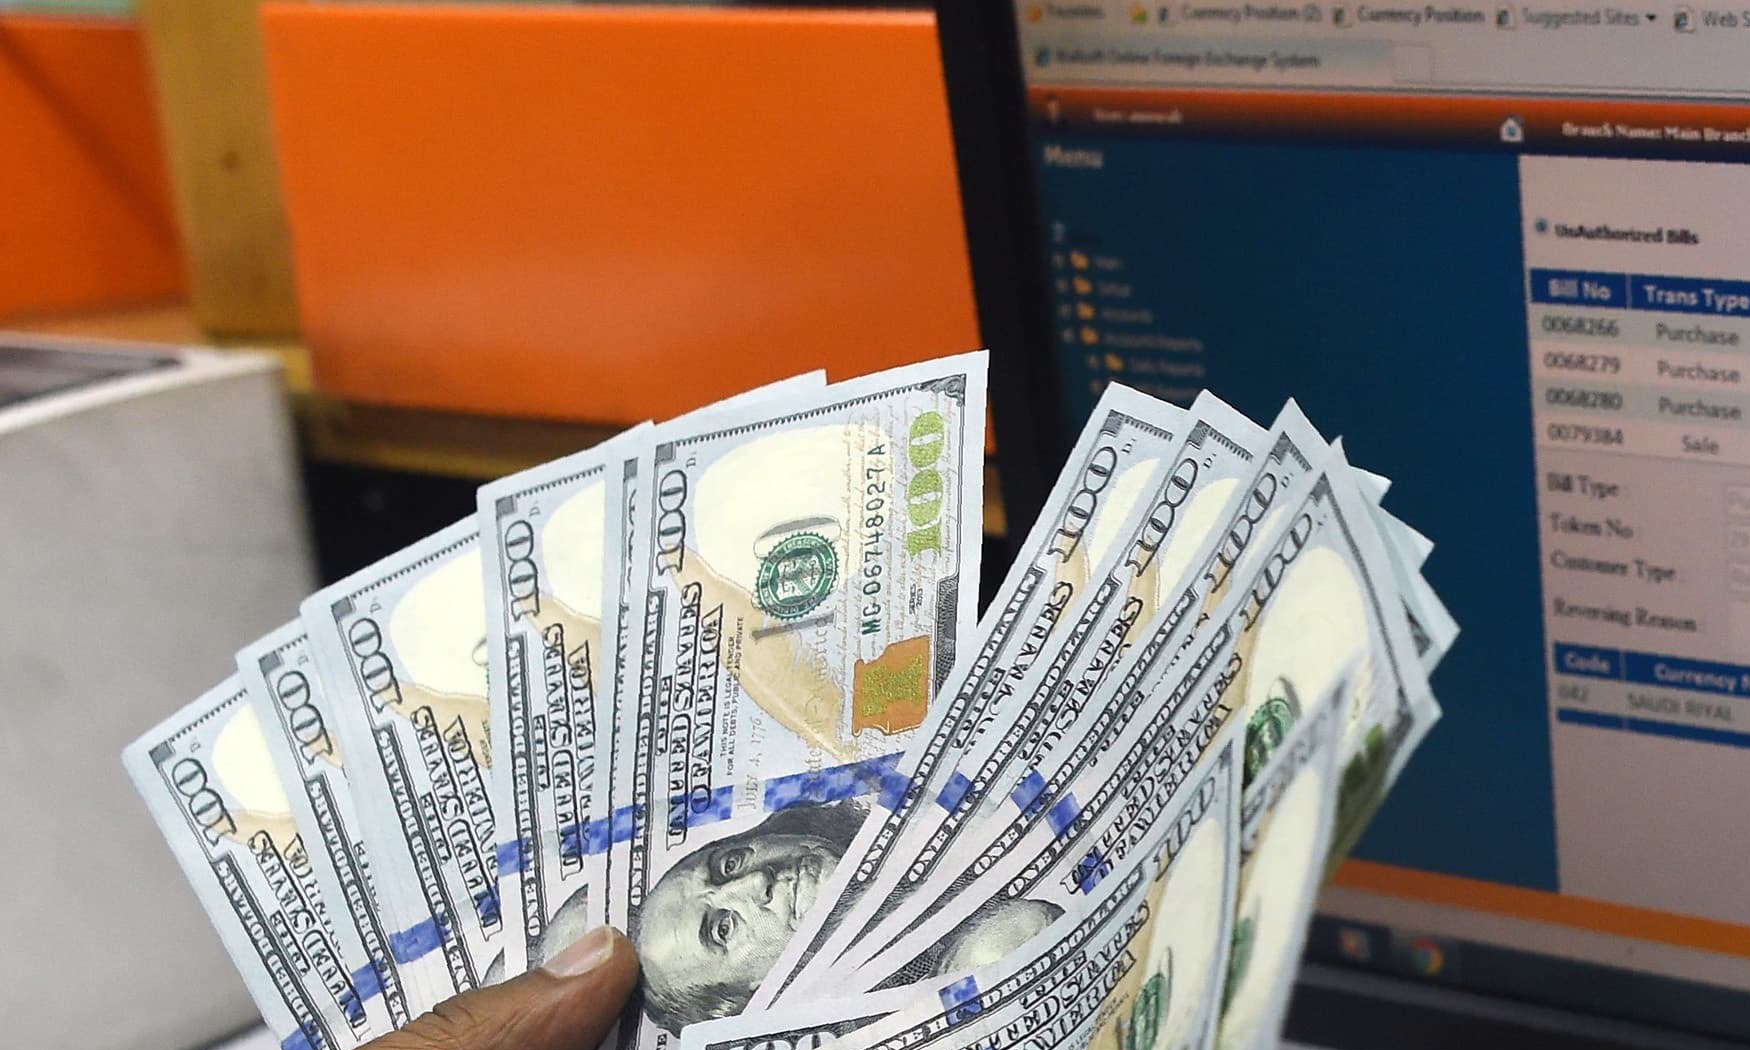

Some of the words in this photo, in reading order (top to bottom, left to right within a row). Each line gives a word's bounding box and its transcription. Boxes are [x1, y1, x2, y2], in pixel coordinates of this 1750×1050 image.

[1522, 9, 1600, 29] Suggested
[1704, 11, 1739, 27] Web
[1664, 125, 1701, 141] Main
[1554, 223, 1663, 245] UnAuthorized
[1666, 230, 1699, 247] Bills
[1548, 279, 1578, 298] Bill
[1582, 282, 1612, 301] No
[1644, 285, 1698, 306] Trans
[1702, 288, 1750, 311] Type
[1541, 314, 1620, 340] 0068266
[1655, 322, 1740, 347] Purchase
[1543, 349, 1621, 376] 0068279
[1656, 360, 1740, 384] Purchase
[1658, 396, 1741, 421] Purchase
[1681, 433, 1720, 456] Sale
[907, 410, 945, 557] 100
[1578, 474, 1619, 497] Type
[1047, 446, 1118, 563] 100
[1125, 457, 1199, 578] 100
[656, 469, 688, 577] 100
[1204, 472, 1278, 593] 100
[505, 520, 541, 621] 100
[1550, 551, 1629, 576] Customer
[1635, 558, 1676, 581] Type
[1553, 598, 1632, 627] Reversing
[1635, 610, 1697, 632] Reason
[349, 617, 402, 714] 100
[1564, 652, 1611, 673] Code
[1653, 663, 1737, 694] Currency
[277, 670, 333, 765] 100
[171, 757, 238, 847] 100
